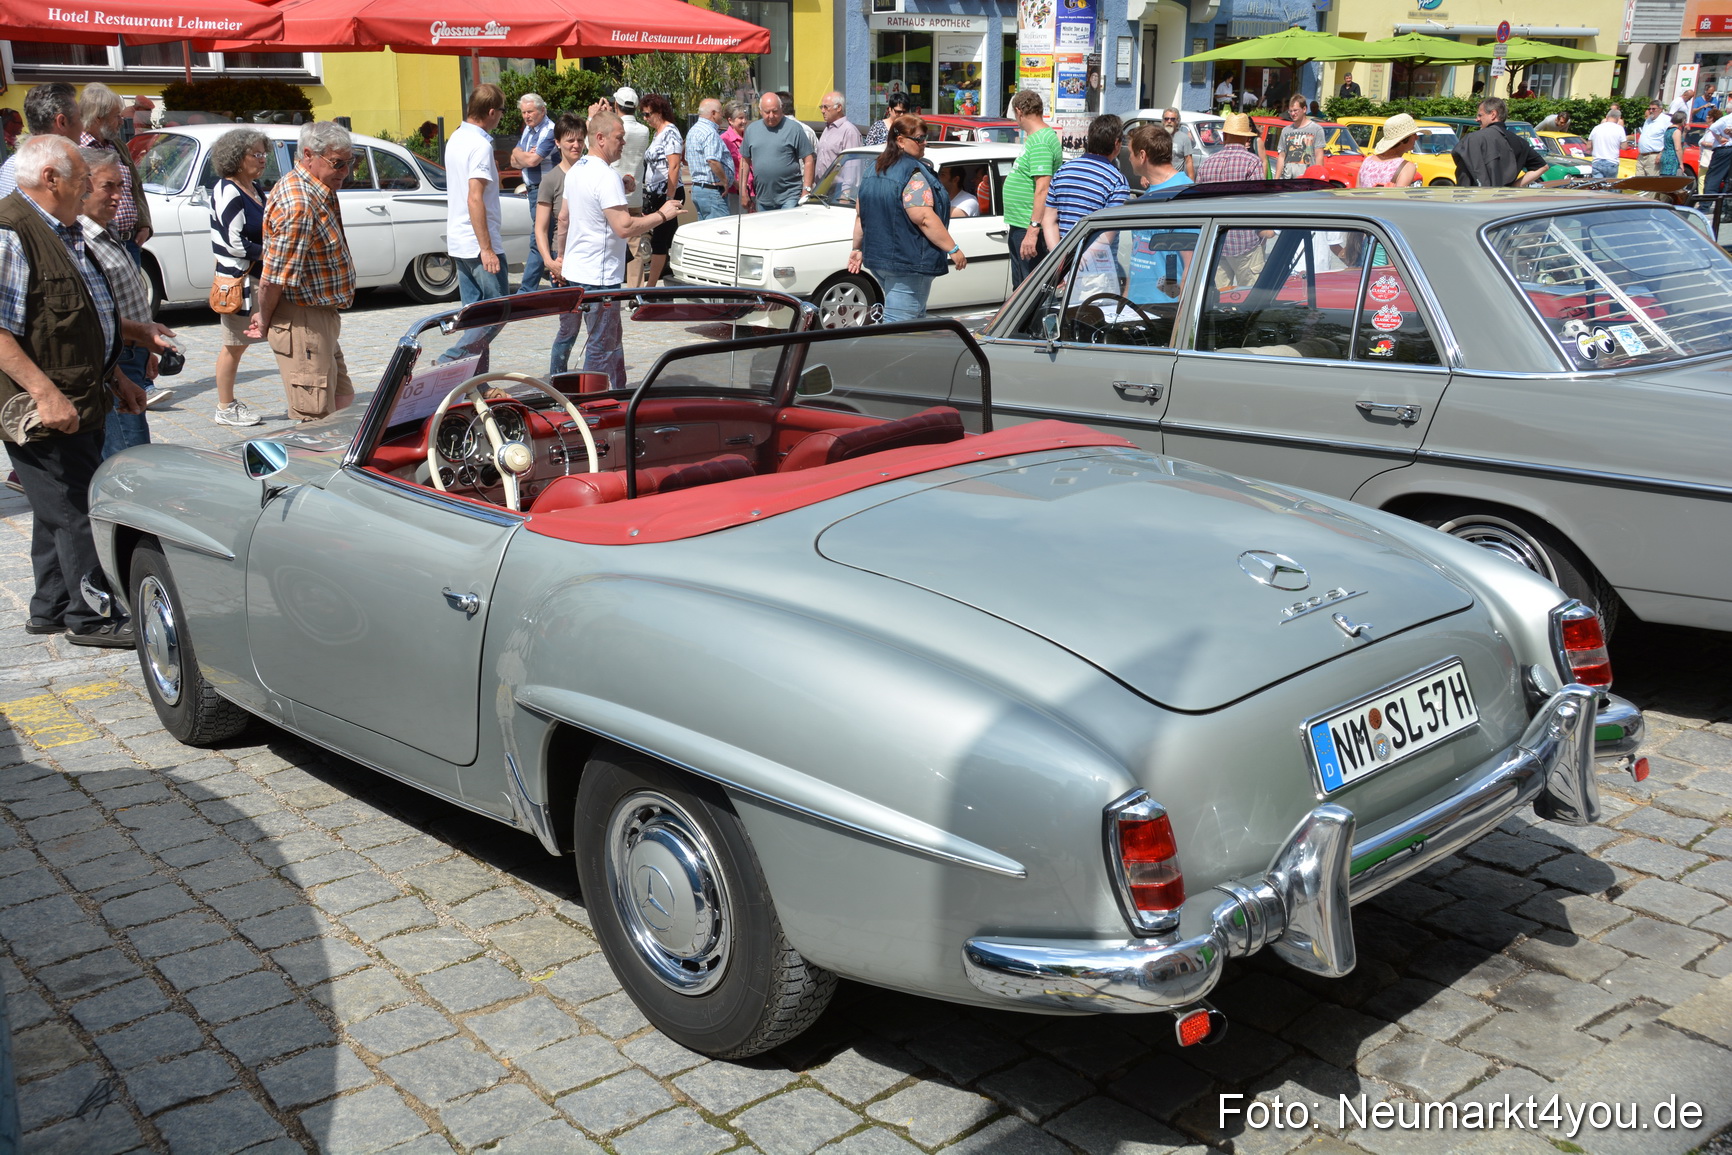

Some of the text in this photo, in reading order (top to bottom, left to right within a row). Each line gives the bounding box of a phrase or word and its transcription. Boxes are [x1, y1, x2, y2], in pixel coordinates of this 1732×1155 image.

[48, 8, 243, 31] Hotel Restaurant Lehmeier
[887, 17, 970, 28] RATHAUS APOTHEKE
[1623, 0, 1634, 41] KINO
[430, 20, 511, 45] Glossner-Bier
[611, 30, 742, 47] Hotel Restaurant Lehmeier
[1332, 715, 1375, 775] NM
[1326, 763, 1334, 778] D
